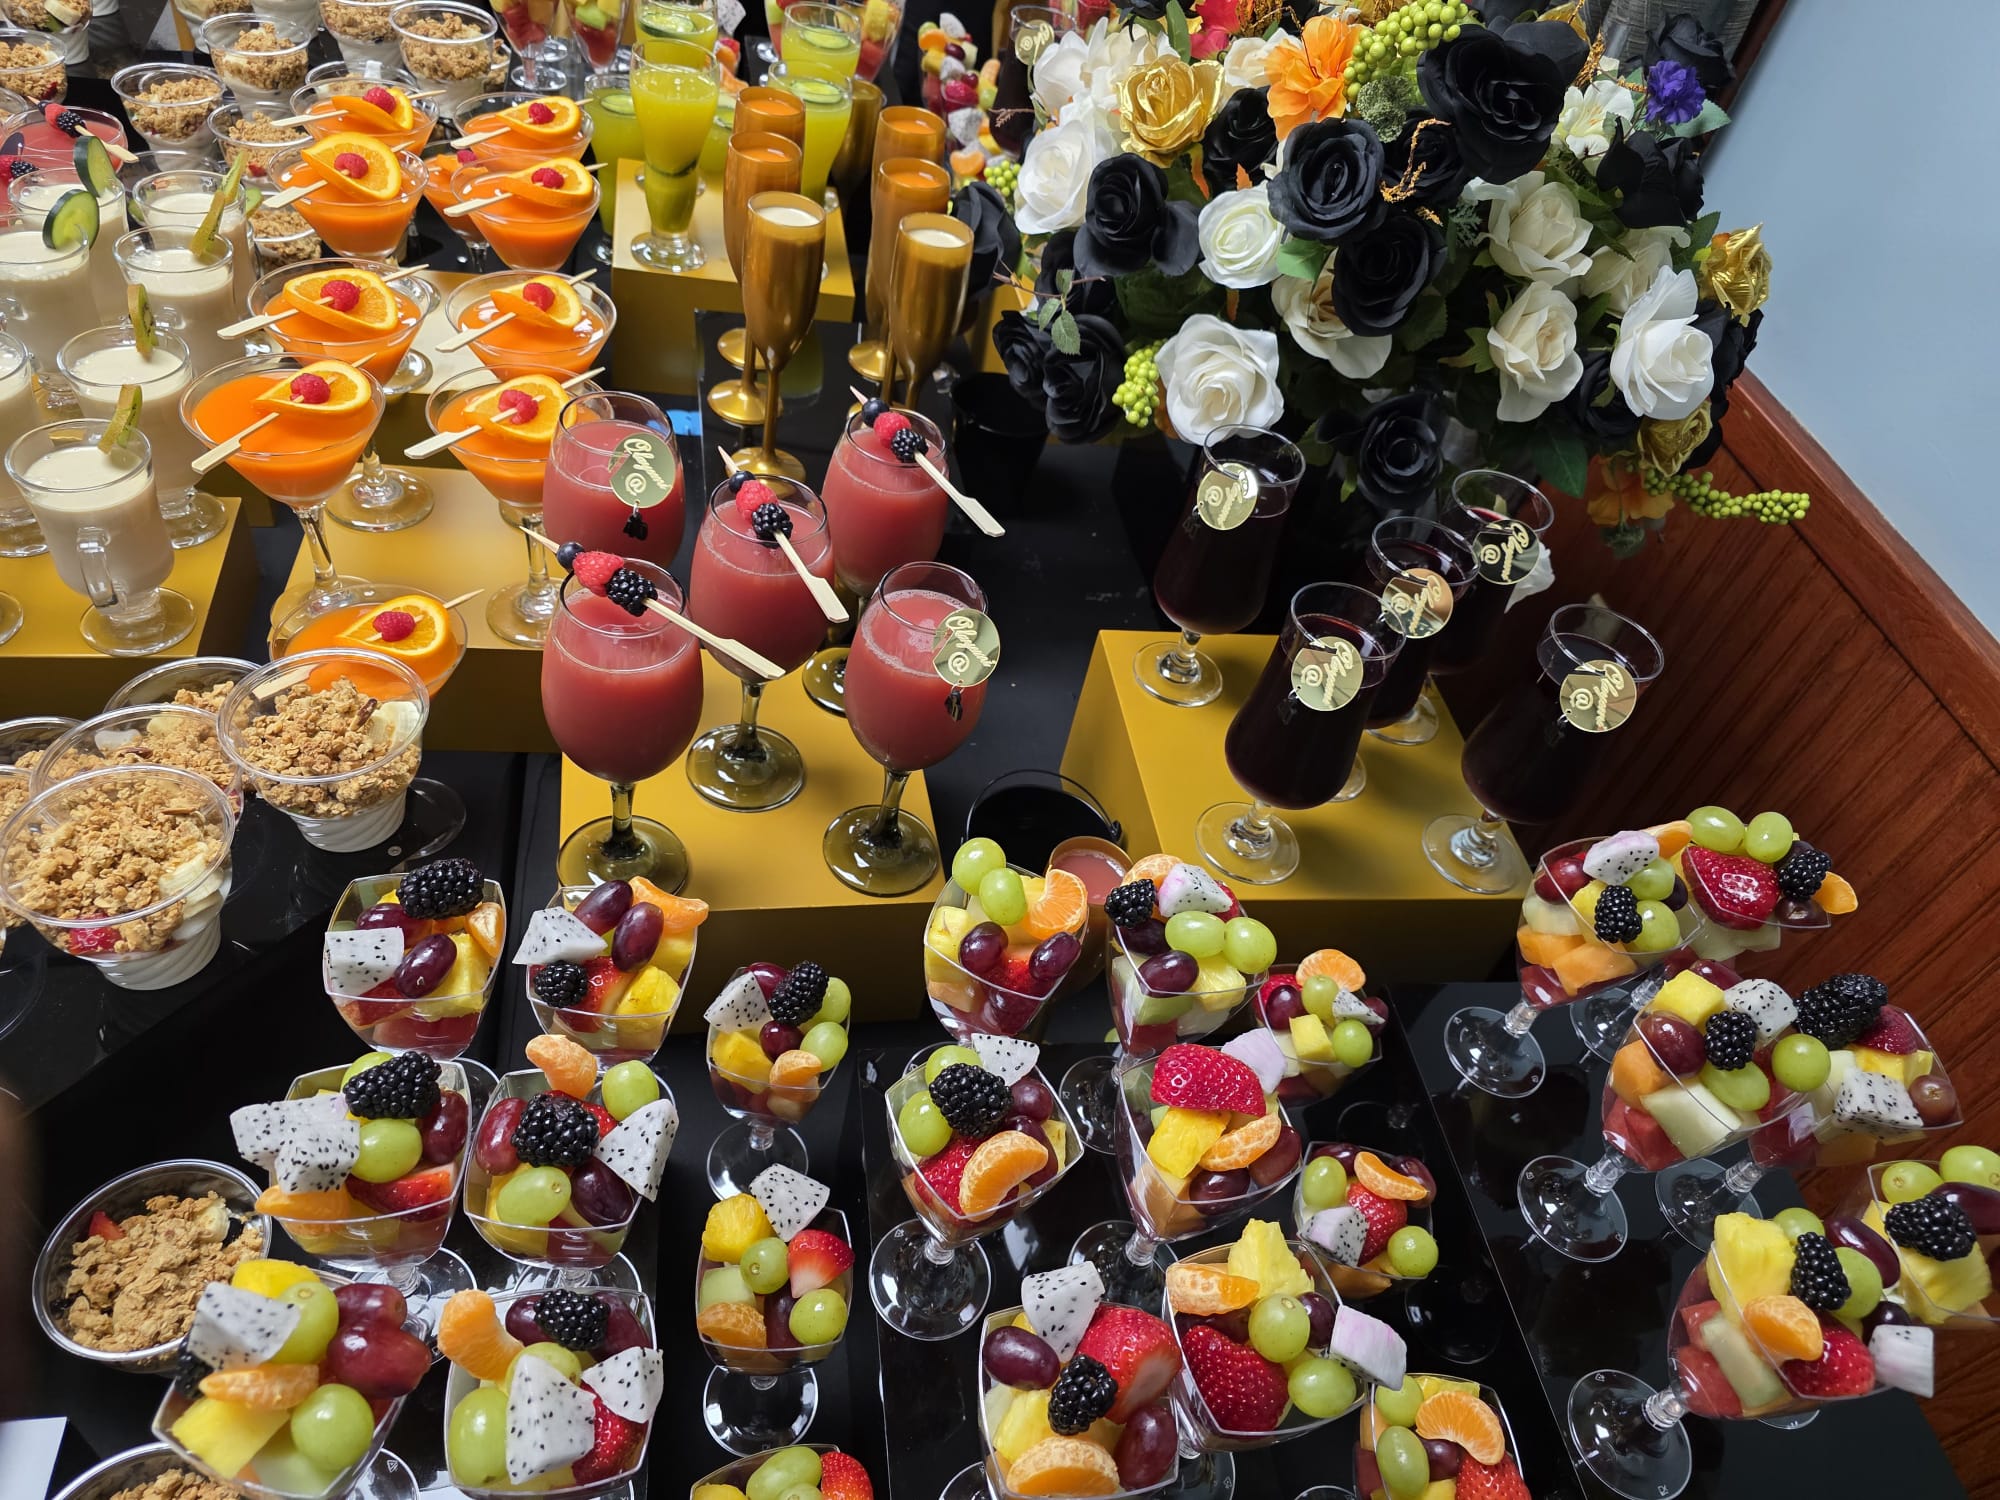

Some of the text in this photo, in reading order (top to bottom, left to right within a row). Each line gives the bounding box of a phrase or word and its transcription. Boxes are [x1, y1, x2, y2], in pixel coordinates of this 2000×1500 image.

[625, 473, 647, 496] @
[1205, 485, 1224, 507] @
[1481, 544, 1501, 565] @
[1391, 592, 1412, 614] @
[948, 651, 970, 676] @
[1301, 664, 1323, 687] @
[1569, 687, 1593, 710] @
